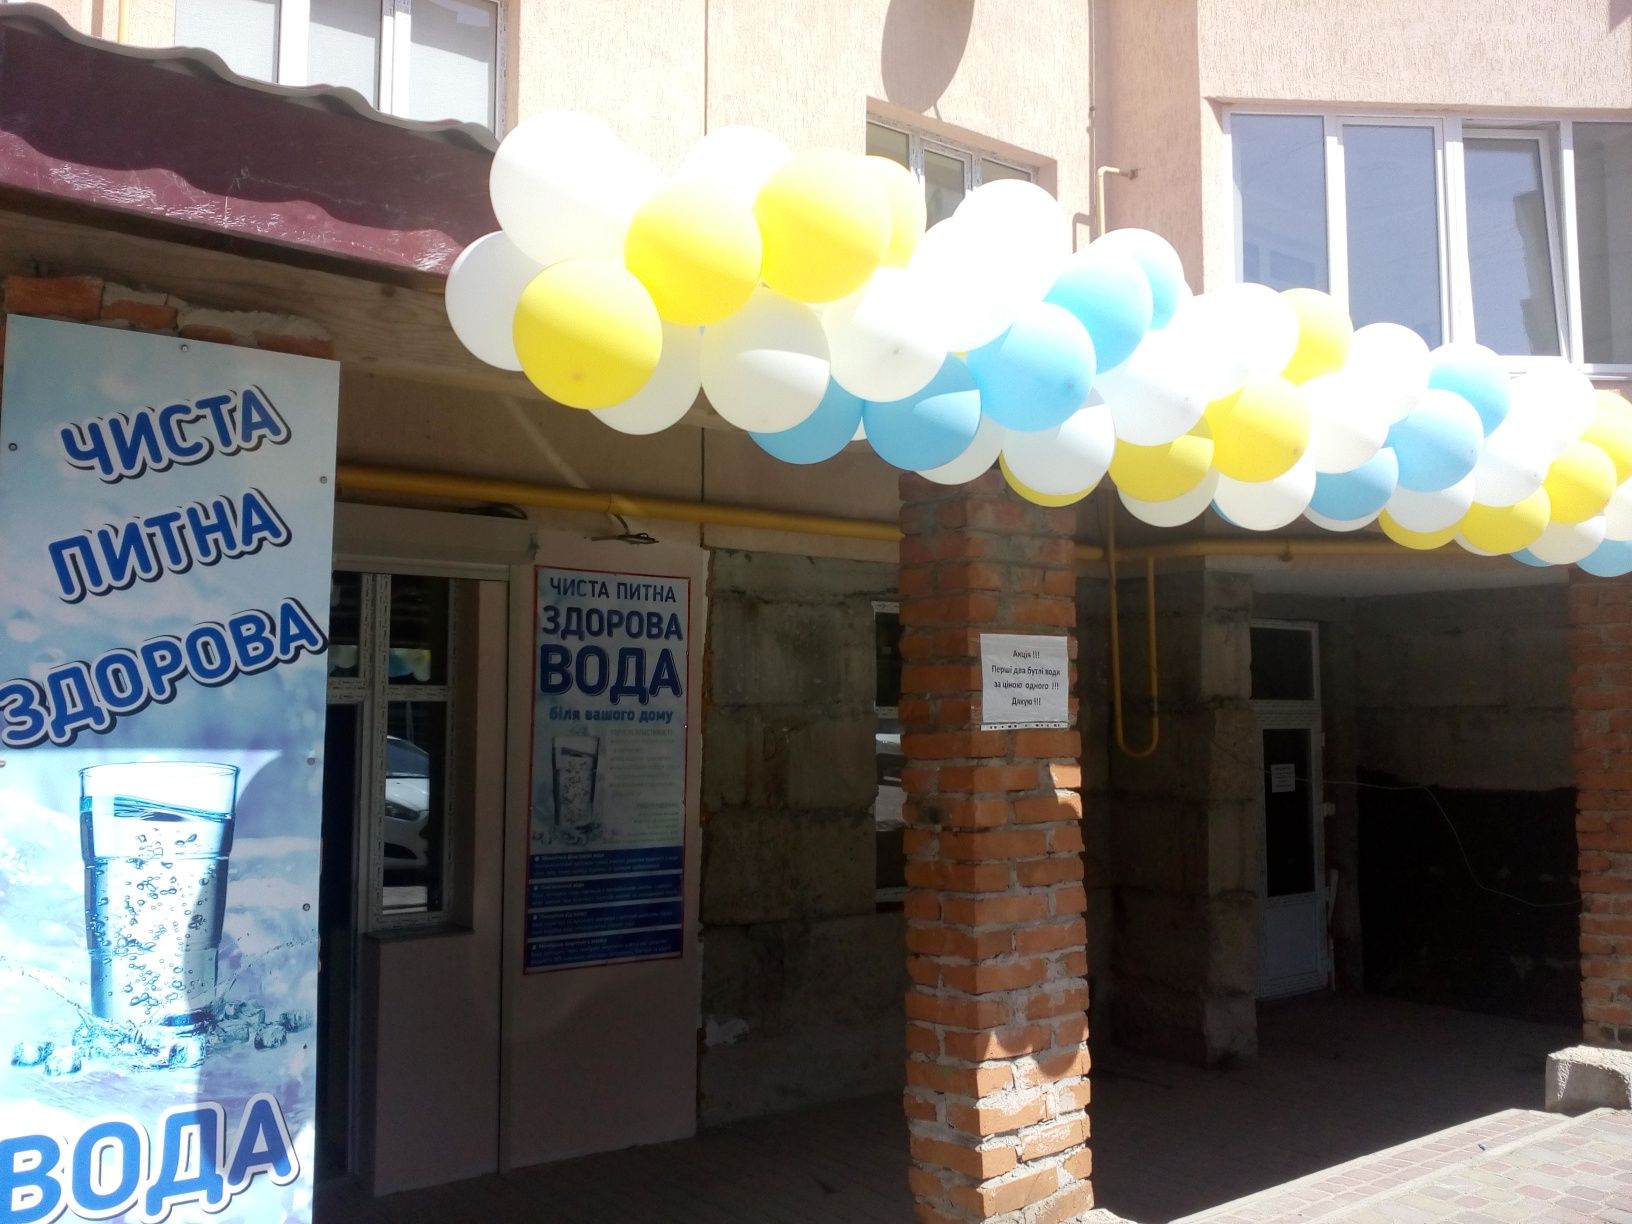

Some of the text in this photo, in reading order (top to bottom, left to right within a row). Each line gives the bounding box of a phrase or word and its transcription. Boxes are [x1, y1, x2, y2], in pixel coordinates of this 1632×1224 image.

[60, 386, 288, 481] ЧИСТА
[48, 490, 288, 600] ПИТНА
[550, 577, 676, 603] ЧИСТА ПИТНА
[541, 604, 684, 642] ЗДОРОВА
[991, 665, 1012, 675] Перші
[1027, 666, 1044, 676] бутлі
[1032, 650, 1040, 659] !!!
[0, 600, 326, 746] ЗДОРОВА
[539, 643, 683, 706] ВОДА
[1002, 680, 1022, 689] ціною
[1051, 682, 1059, 690] !!!
[549, 706, 674, 725] біля вашого дому
[1011, 697, 1033, 707] Дякую
[0, 1095, 297, 1224] ВОДА
